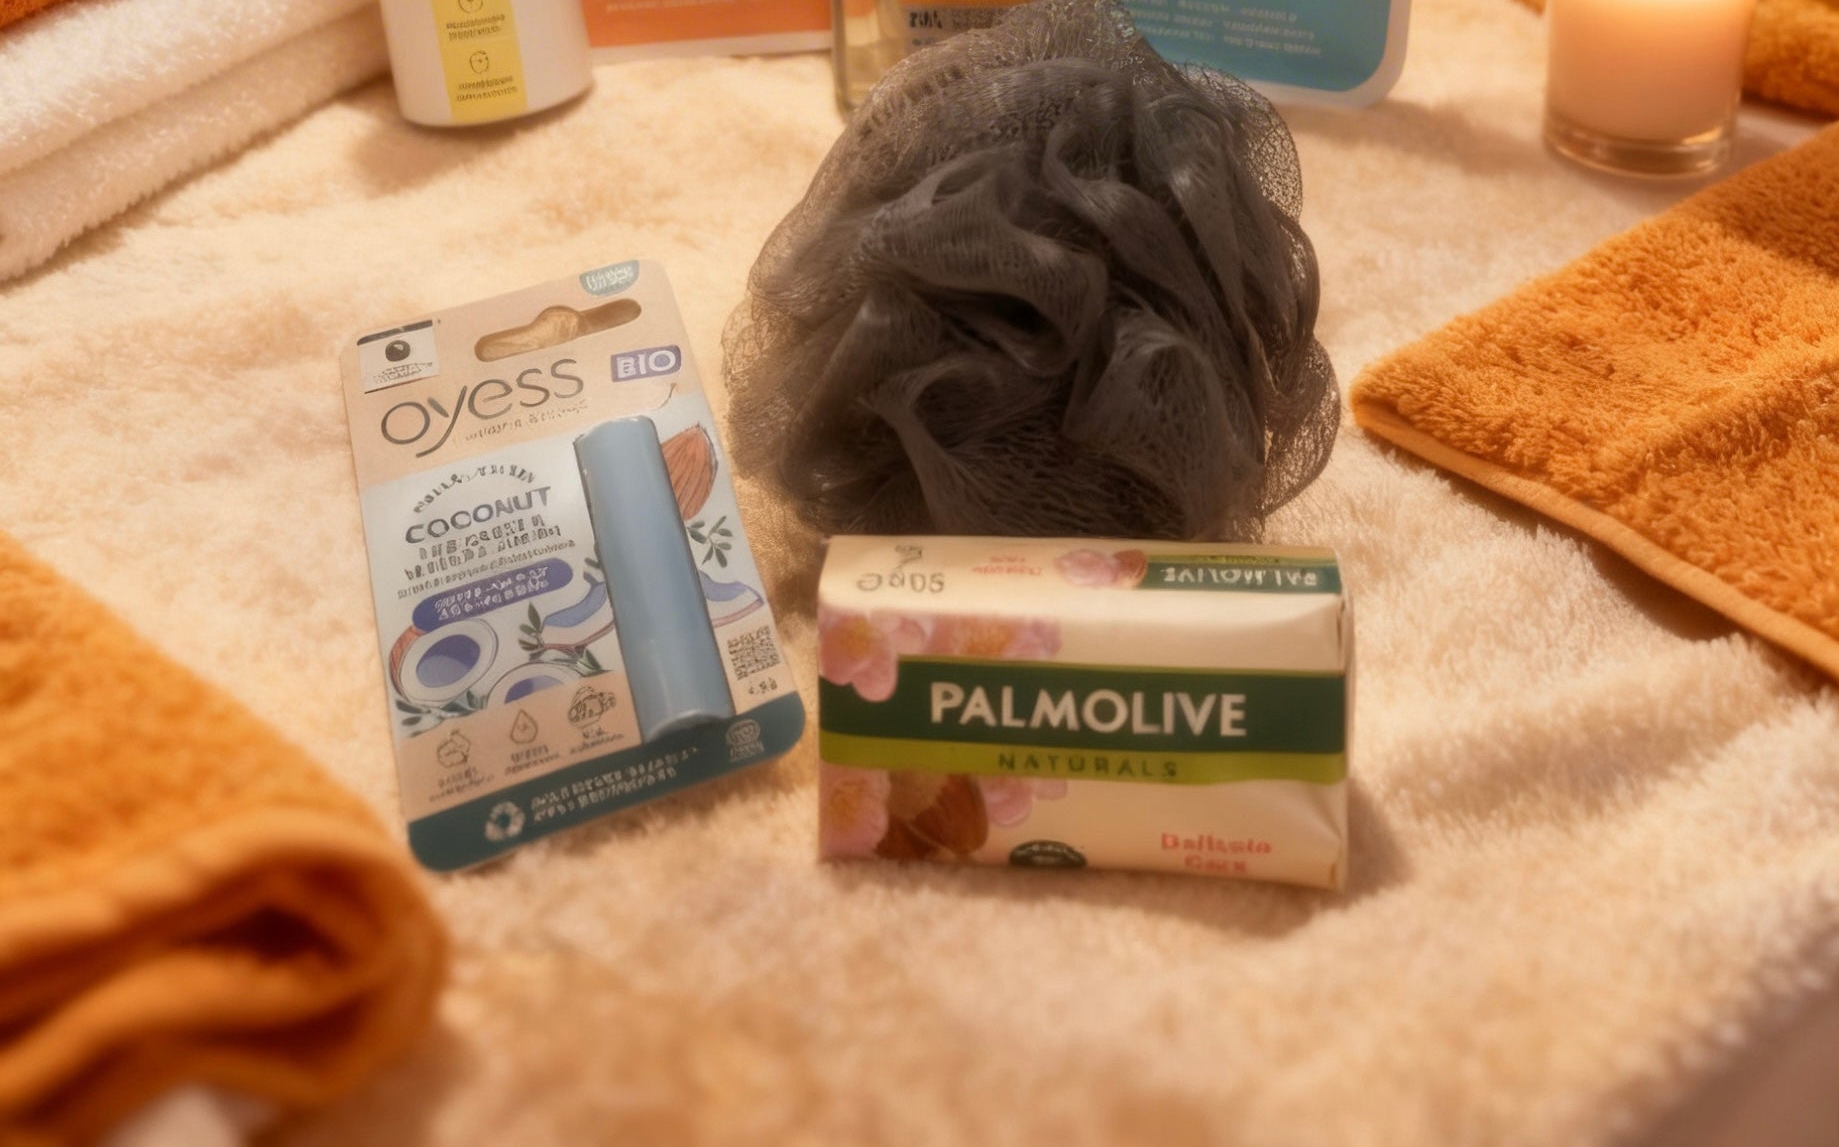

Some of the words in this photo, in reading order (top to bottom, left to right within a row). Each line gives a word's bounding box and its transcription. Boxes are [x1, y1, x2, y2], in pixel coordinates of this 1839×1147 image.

[616, 350, 676, 378] BIO
[380, 358, 584, 458] oyess
[405, 486, 551, 544] COCONUT
[930, 682, 1247, 737] PALMOLIVE
[998, 752, 1179, 778] NATURALS
